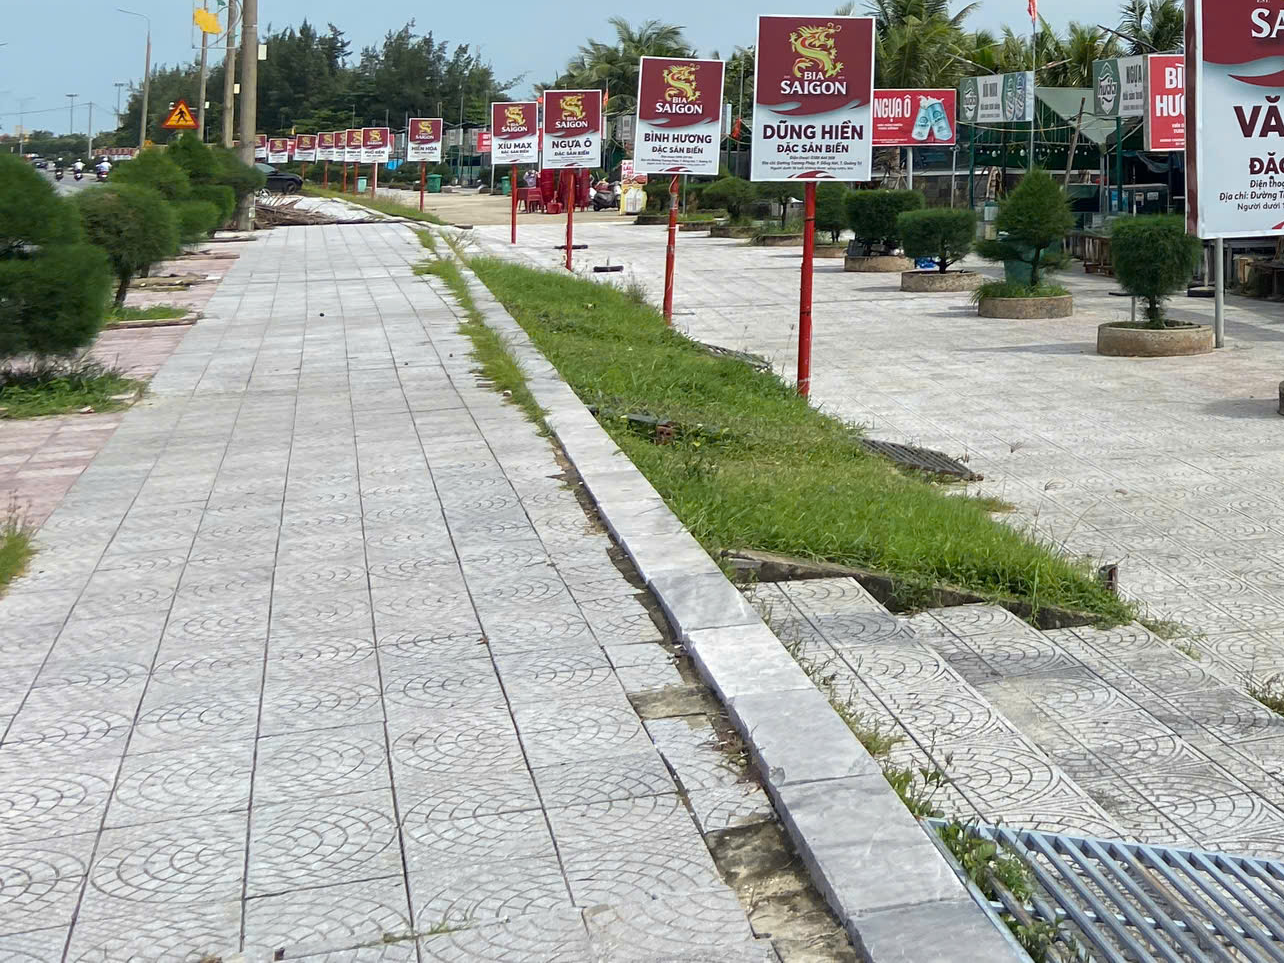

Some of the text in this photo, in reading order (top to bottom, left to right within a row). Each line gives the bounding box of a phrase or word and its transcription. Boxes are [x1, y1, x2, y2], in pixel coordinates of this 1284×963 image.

[804, 71, 824, 80] BIA
[780, 80, 847, 95] SAIGON
[655, 102, 703, 114] SAIGON
[874, 94, 911, 123] NGỰA Ô
[555, 120, 588, 129] SAIGON
[762, 119, 864, 140] DŨNG HIỀN
[644, 130, 712, 144] BÌNH HƯƠNG
[552, 138, 592, 151] NGỰA Ô
[777, 141, 849, 155] ĐẶC SẢN BIỂN
[1219, 192, 1233, 203] Địa
[1250, 190, 1278, 201] Đường
